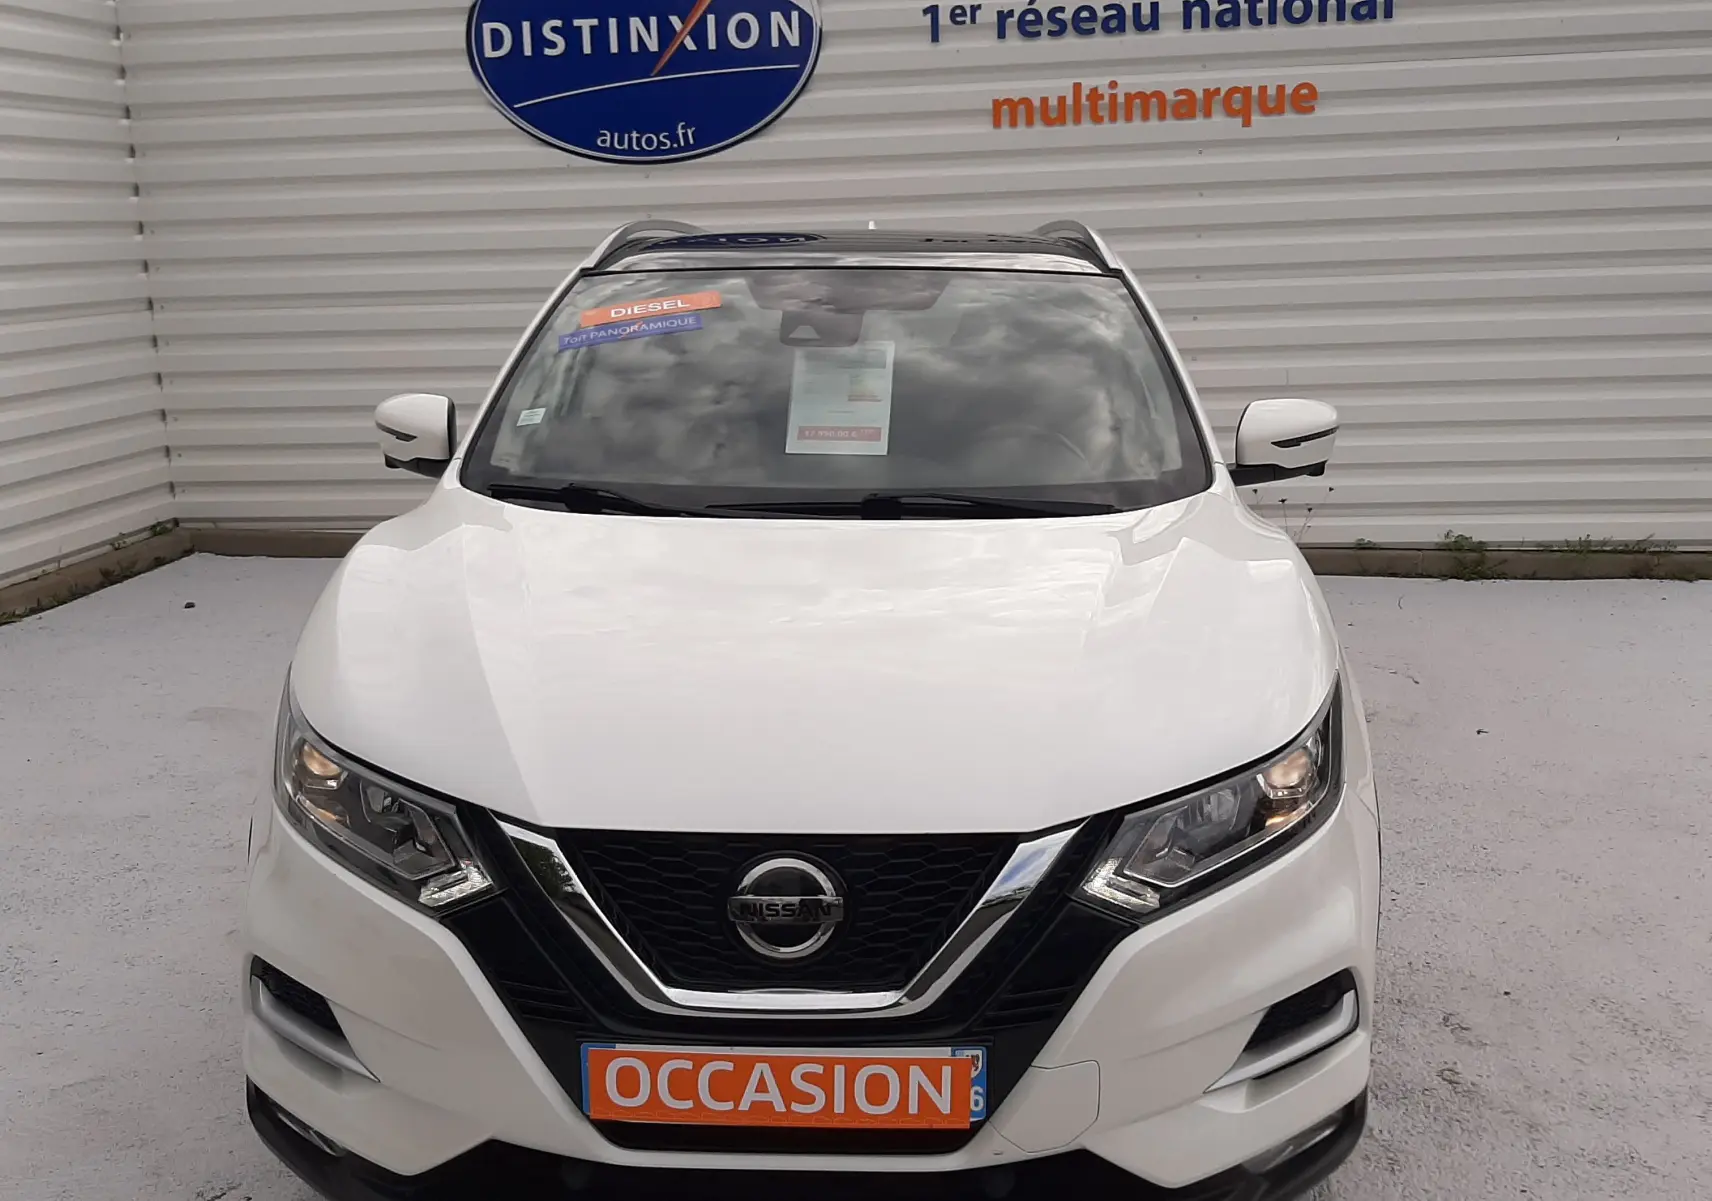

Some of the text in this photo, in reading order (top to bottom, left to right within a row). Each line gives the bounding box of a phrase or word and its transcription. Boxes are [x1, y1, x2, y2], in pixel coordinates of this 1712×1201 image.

[482, 11, 801, 59] DISTINXION
[922, 0, 1395, 43] 1er réseau national
[992, 81, 1318, 129] multimarque
[597, 122, 696, 151] autos.fr
[610, 299, 691, 318] DIESEL
[590, 316, 697, 339] PANORAMIQUE
[738, 902, 833, 918] NISSAN
[604, 1056, 953, 1115] OCCASION
